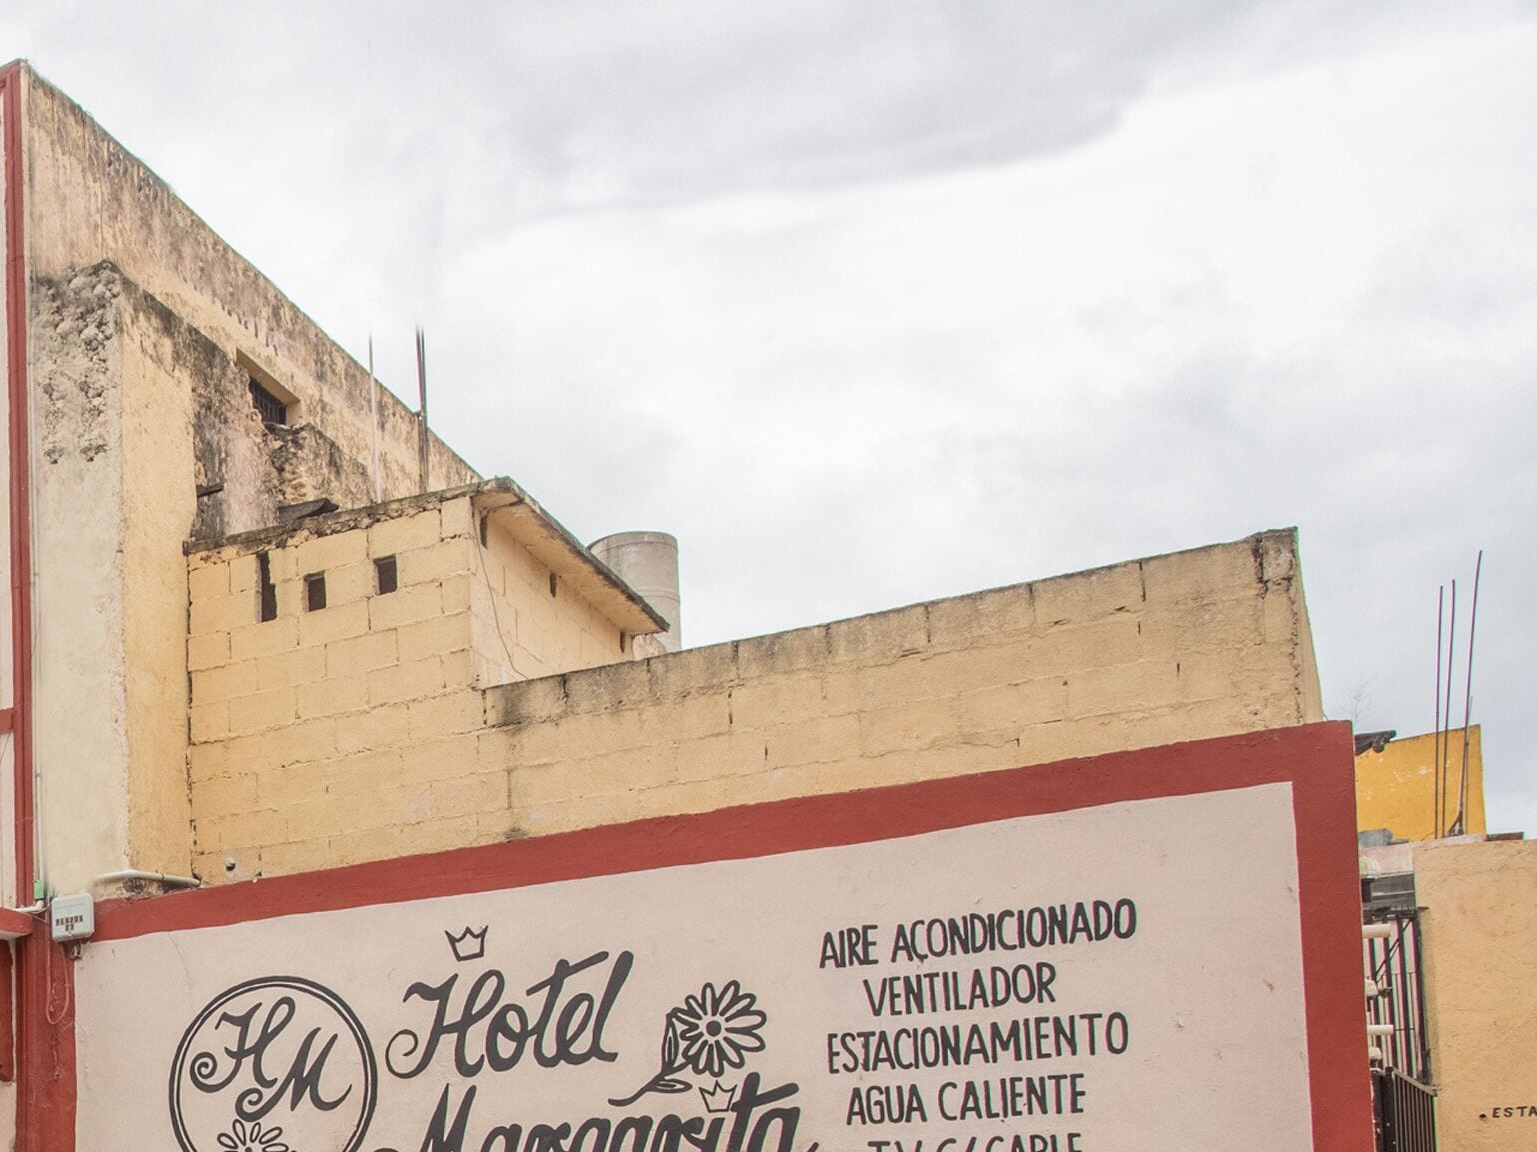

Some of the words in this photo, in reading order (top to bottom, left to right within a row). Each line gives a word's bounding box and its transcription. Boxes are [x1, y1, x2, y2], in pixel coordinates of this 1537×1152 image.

[819, 924, 879, 969] AIRE
[890, 898, 1137, 963] ACONDICIONADO
[385, 950, 634, 1079] Hotel
[863, 962, 1057, 1017] VENTILADOR
[827, 1011, 1129, 1074] ESTACIONAMIENTO
[846, 1083, 928, 1125] AGUA
[937, 1073, 1086, 1120] CALIENTE
